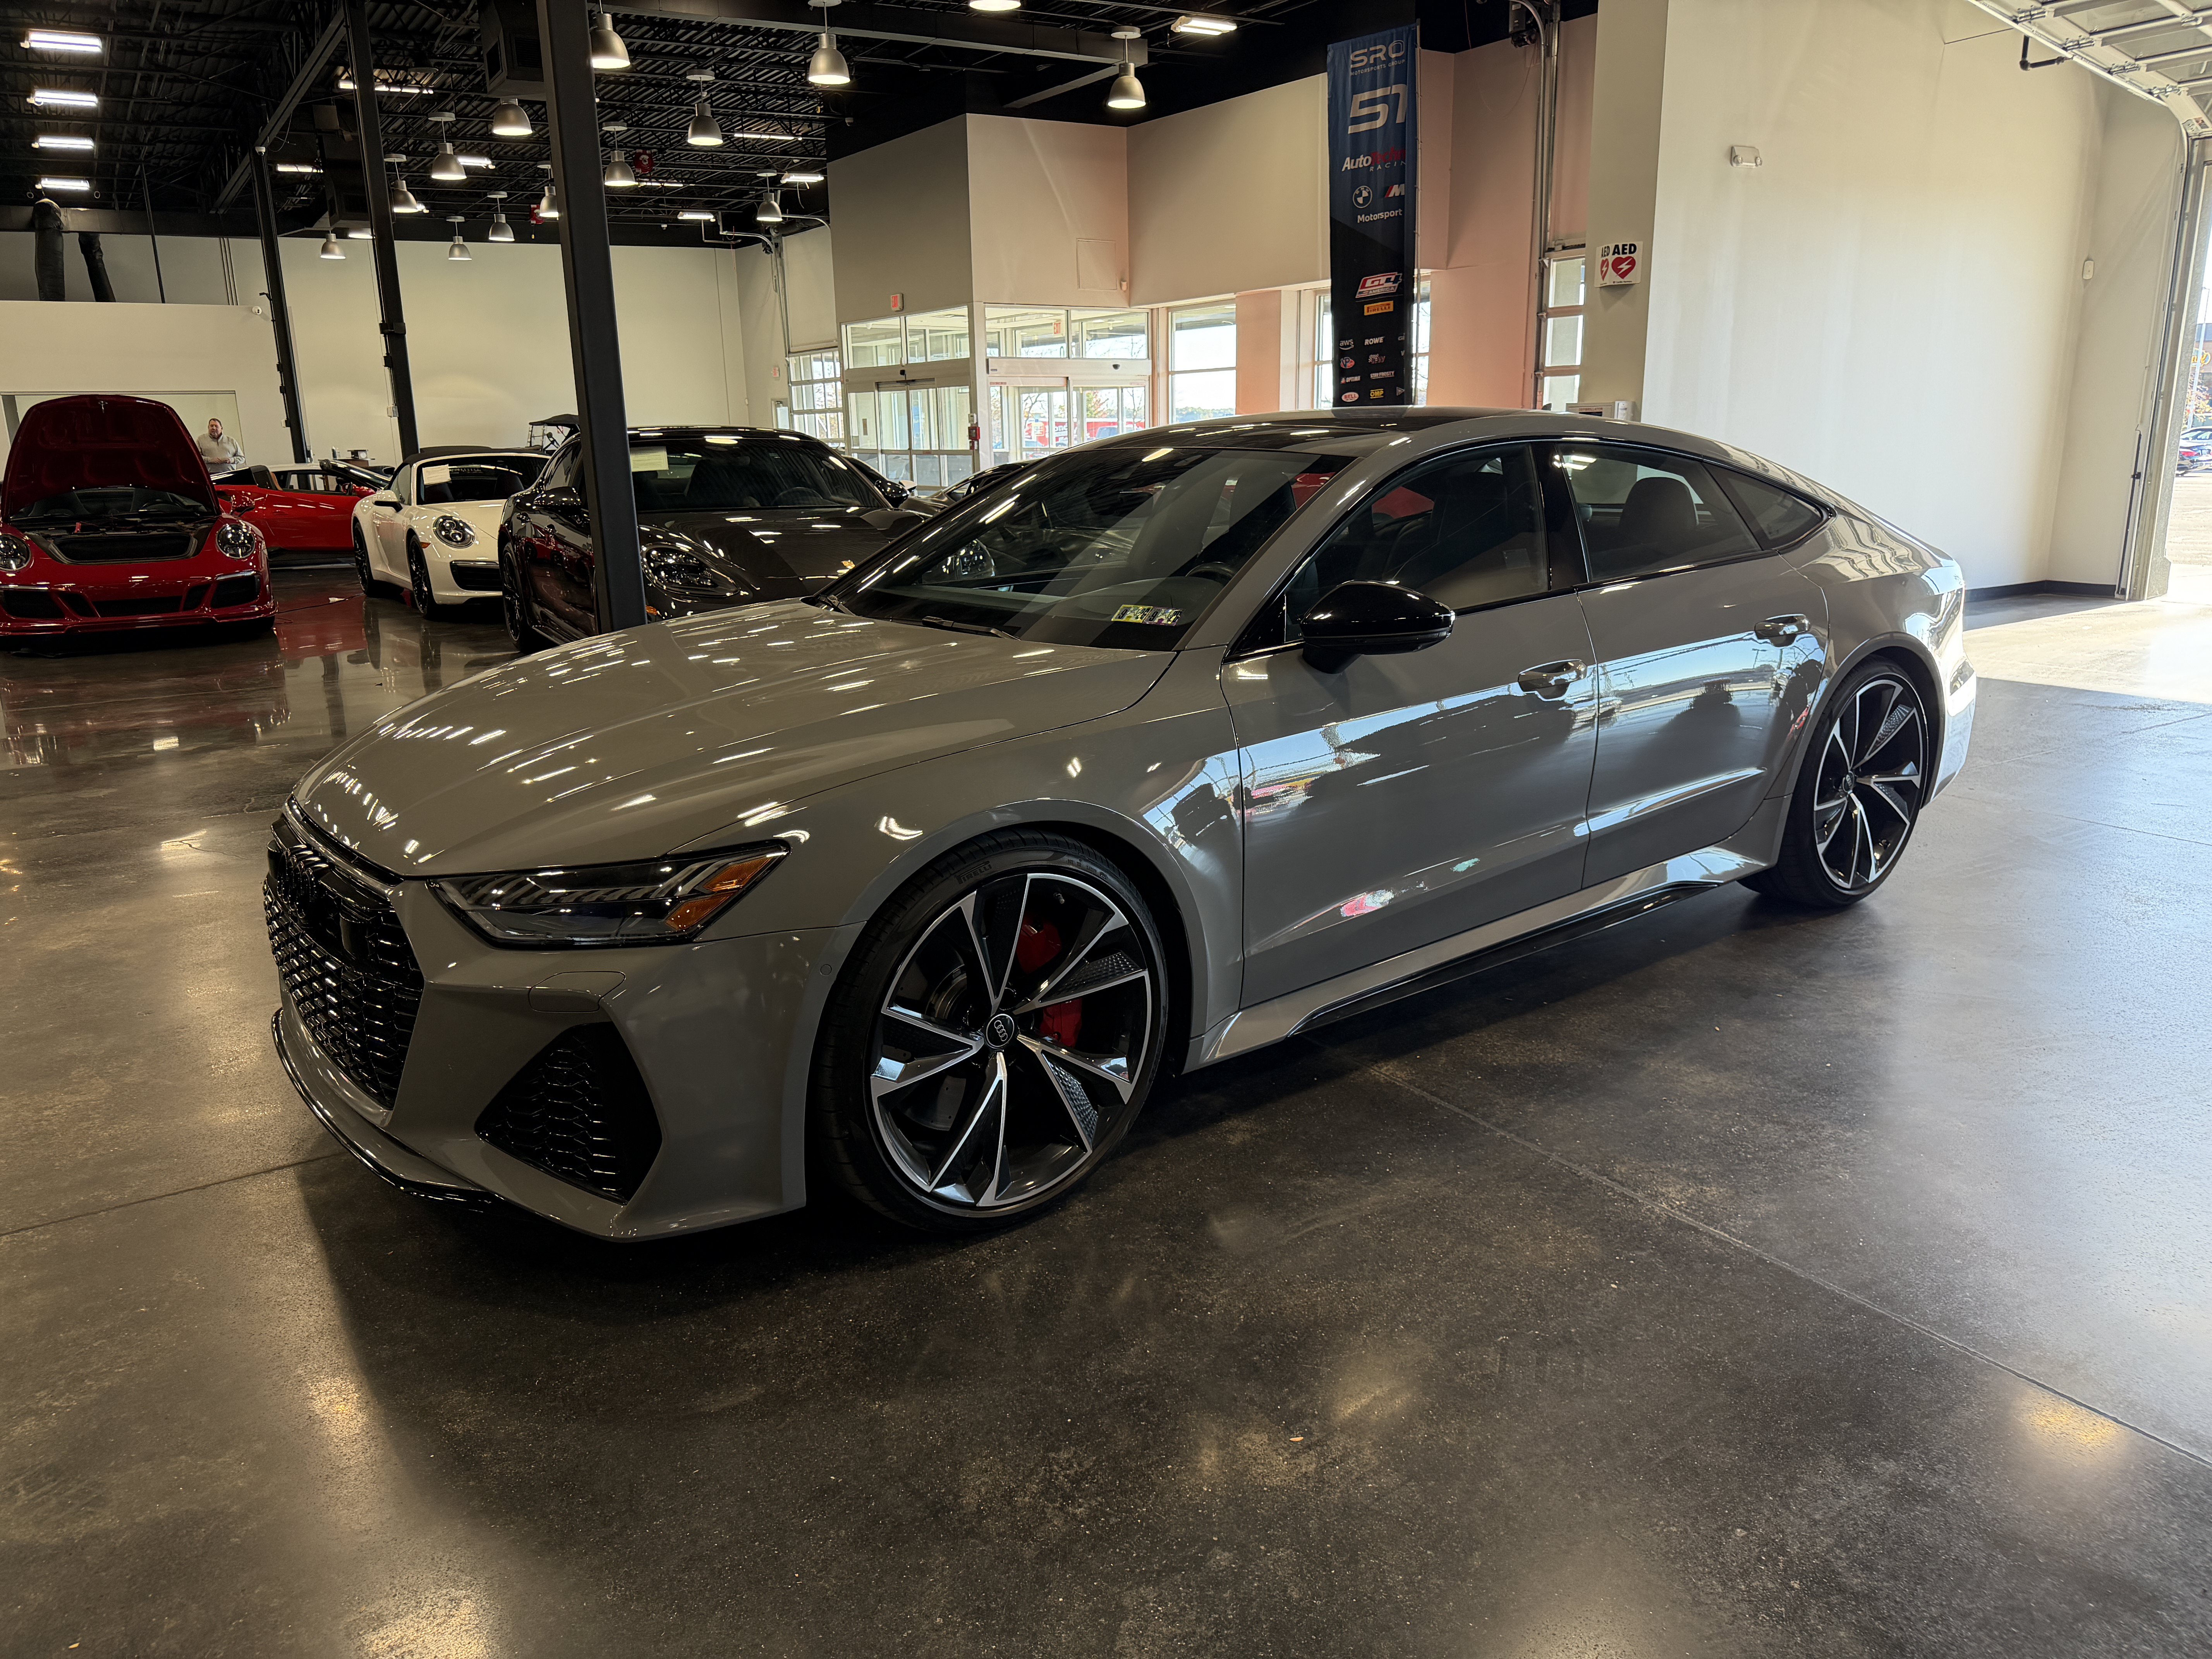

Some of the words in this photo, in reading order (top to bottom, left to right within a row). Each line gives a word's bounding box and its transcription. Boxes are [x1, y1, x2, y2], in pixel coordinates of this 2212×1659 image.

[1350, 40, 1405, 68] SRO
[1350, 64, 1386, 76] MOTORSPORTS
[1357, 208, 1403, 223] Motorsport
[1601, 246, 1610, 258] AED
[1612, 243, 1637, 256] AED
[1365, 273, 1401, 287] GT4
[1367, 303, 1391, 313] PIRELLI
[1364, 336, 1384, 345] ROWE
[1118, 609, 1128, 619] 9
[1149, 611, 1158, 622] 9
[956, 860, 992, 884] PIRELLI
